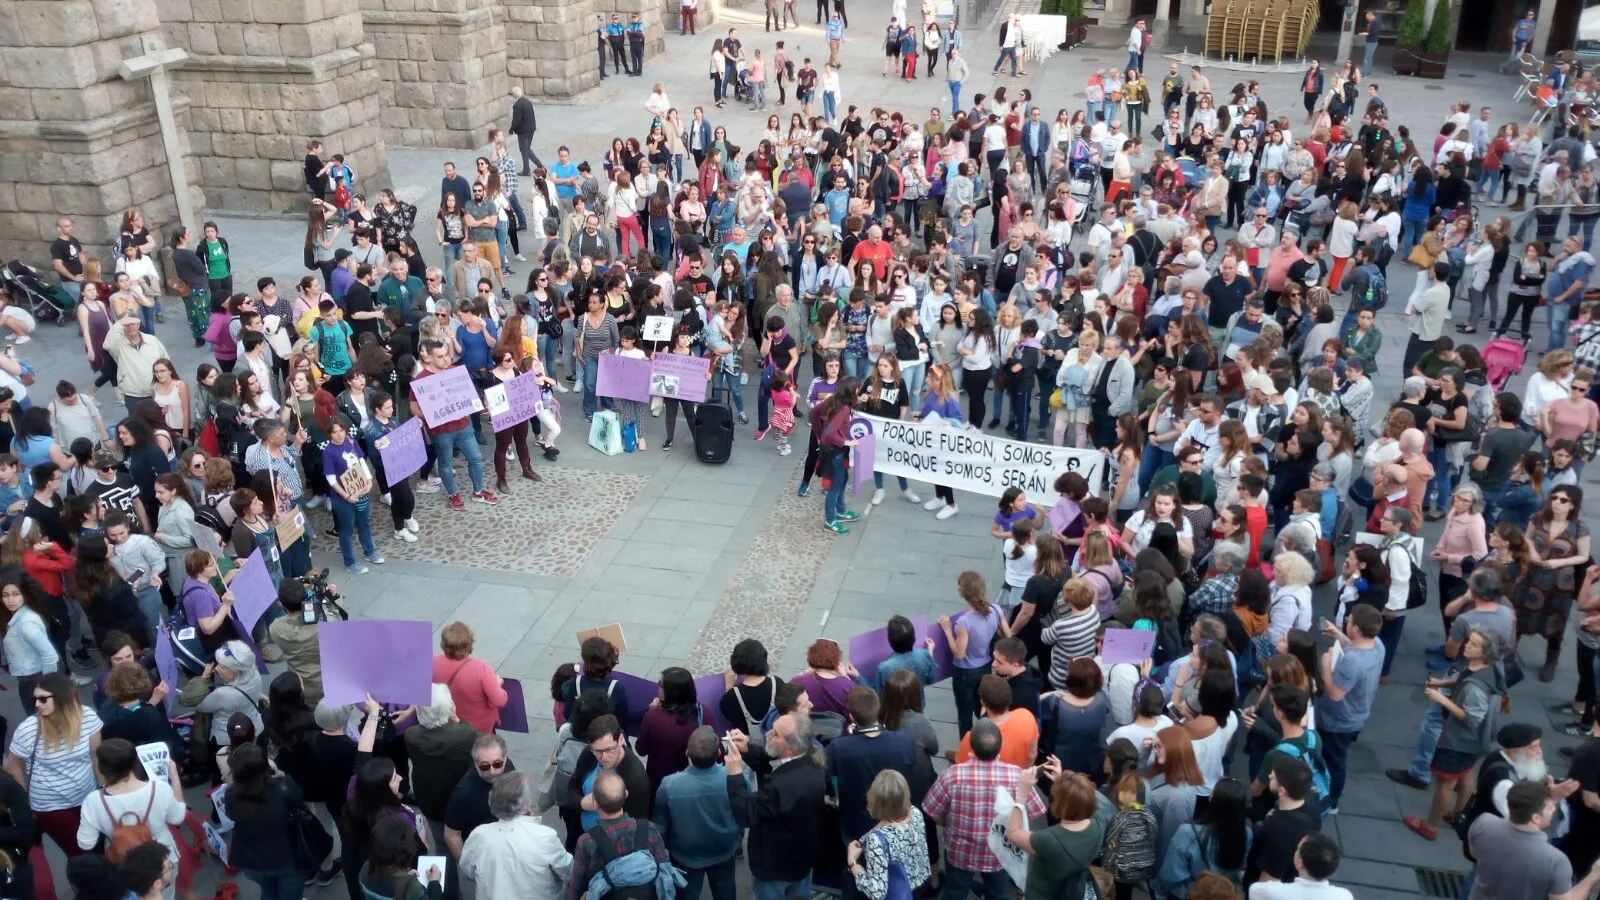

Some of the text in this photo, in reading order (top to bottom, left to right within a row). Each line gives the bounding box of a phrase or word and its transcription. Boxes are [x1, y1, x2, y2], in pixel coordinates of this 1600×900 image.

[882, 421, 1056, 471] PORQUE FUERON, SOMOS,
[344, 468, 358, 486] NO
[887, 447, 1046, 494] PORQUE SOMOS, SERÁN
